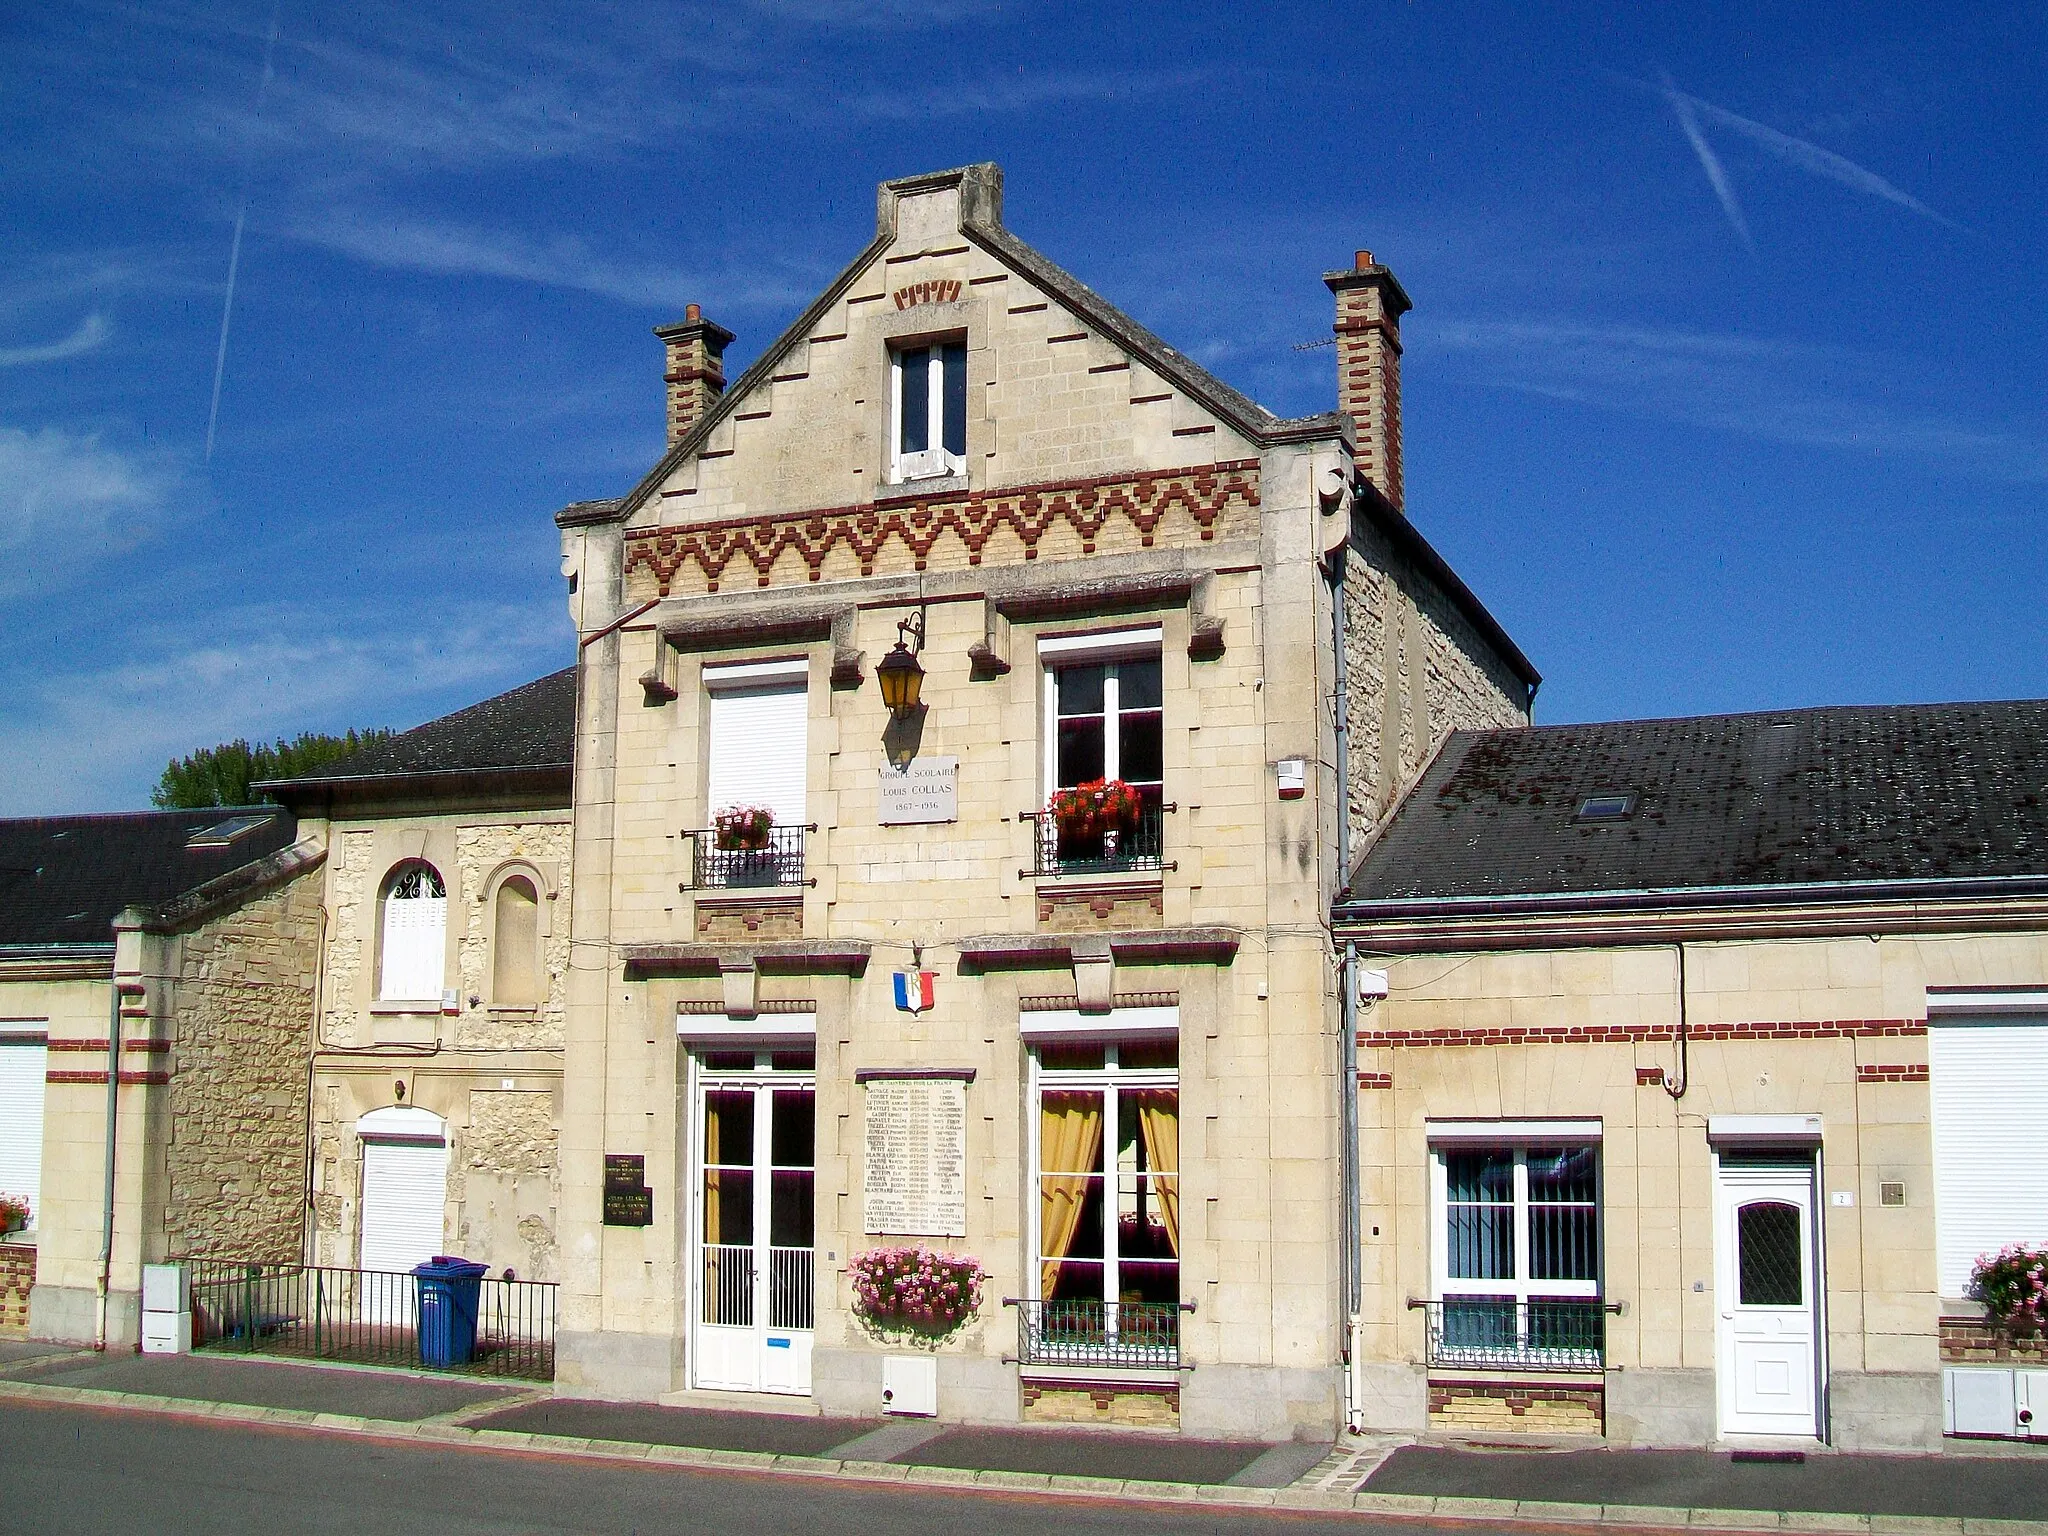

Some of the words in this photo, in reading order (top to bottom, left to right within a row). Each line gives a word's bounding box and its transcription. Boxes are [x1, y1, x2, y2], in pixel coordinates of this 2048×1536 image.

[915, 768, 956, 777] SCOLAIRE
[883, 788, 907, 796] LOUIS
[912, 784, 952, 794] COLLAS
[1839, 1194, 1844, 1204] 2
